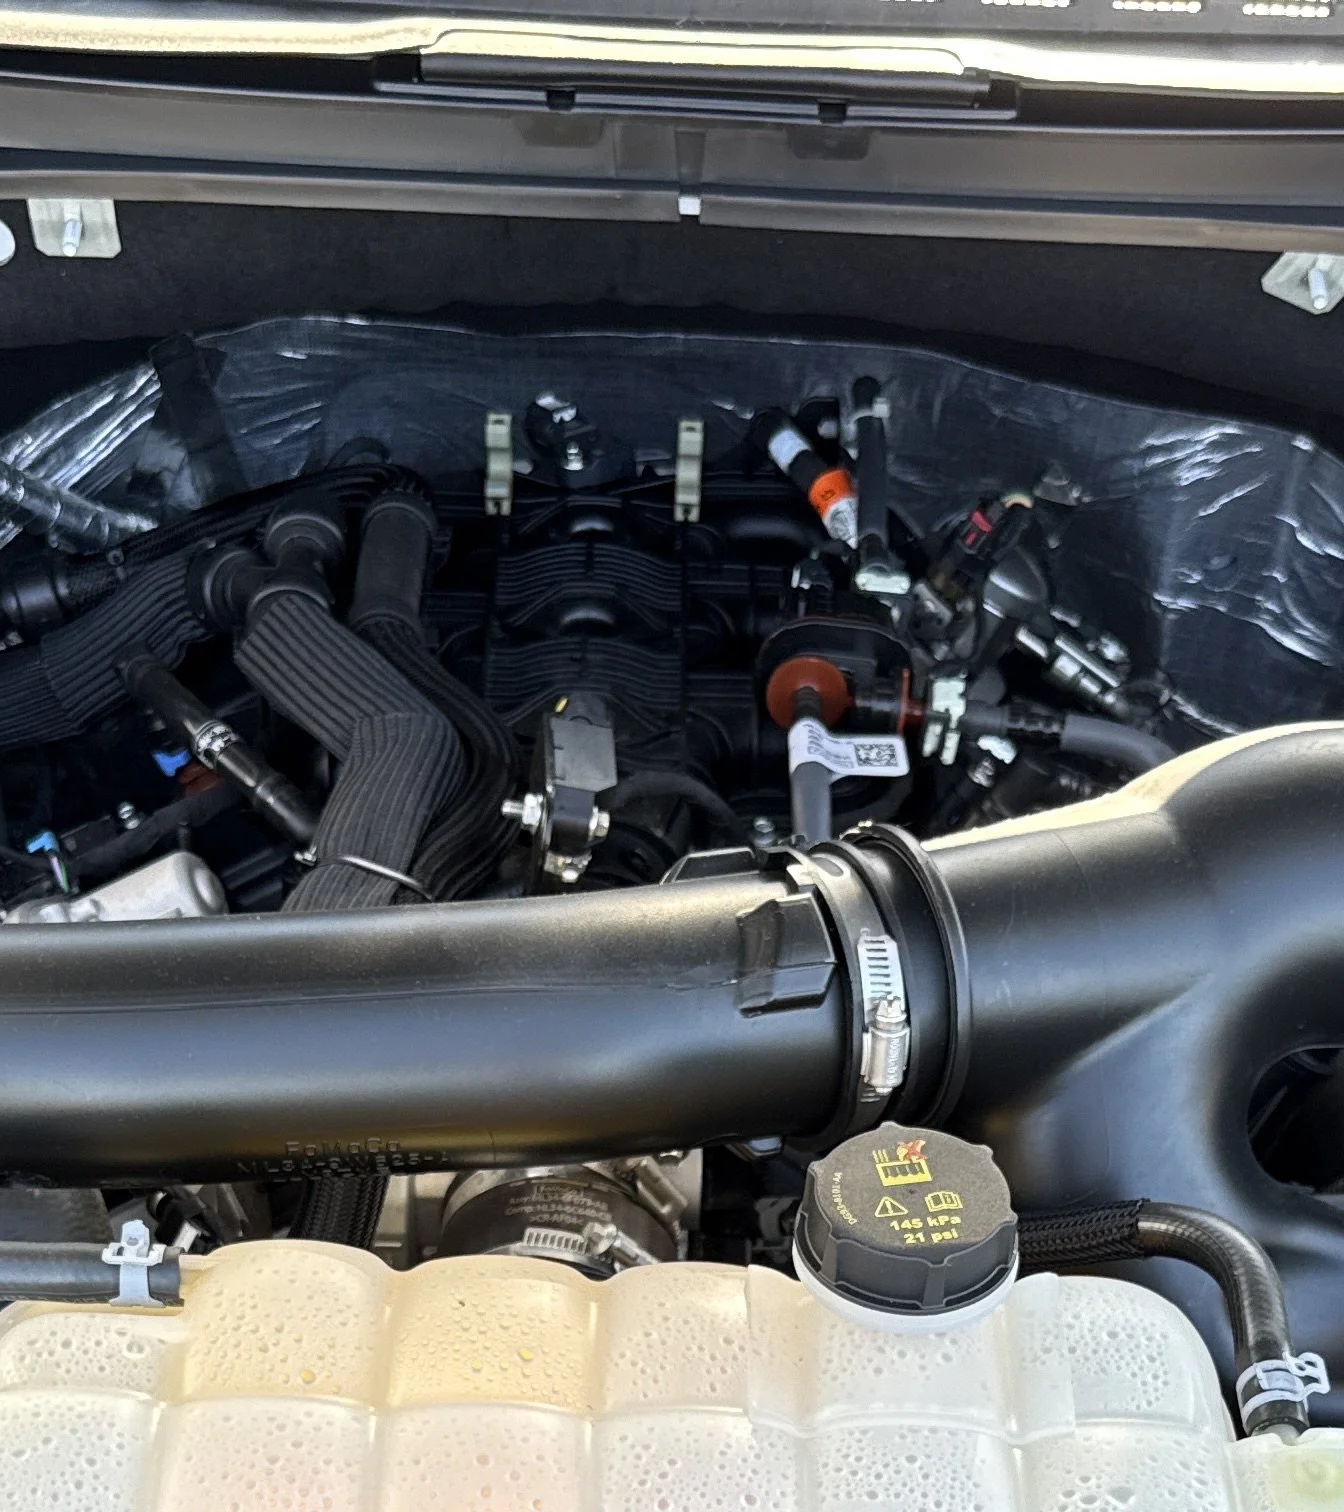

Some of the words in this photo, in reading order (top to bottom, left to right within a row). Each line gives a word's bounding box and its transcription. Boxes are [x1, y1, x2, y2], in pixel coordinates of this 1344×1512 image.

[890, 1218, 922, 1232] 145
[927, 1215, 962, 1227] kPa
[904, 1232, 926, 1244] 21
[932, 1229, 959, 1244] psi
